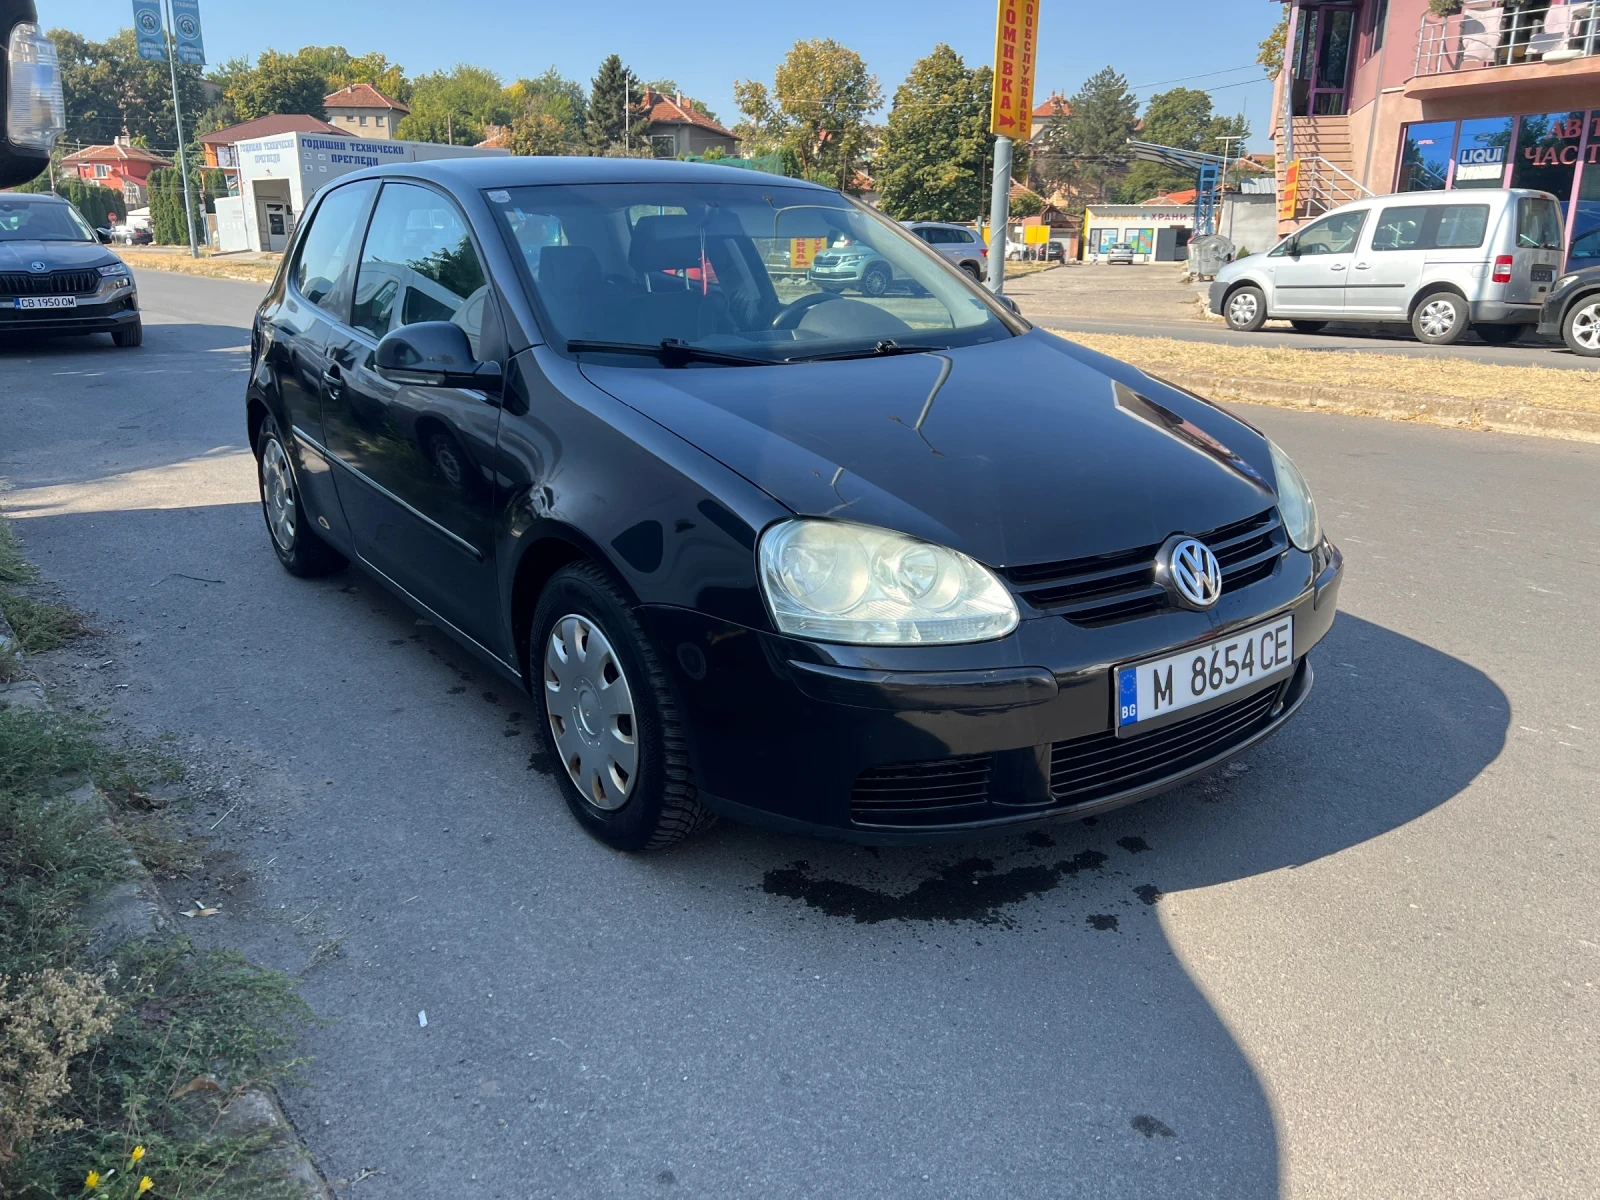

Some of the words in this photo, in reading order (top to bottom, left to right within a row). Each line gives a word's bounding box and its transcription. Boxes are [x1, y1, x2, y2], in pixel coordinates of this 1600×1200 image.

[1019, 0, 1034, 132] ООБСЛУЖВАНЕ
[301, 138, 346, 151] ГОДИШНИ
[350, 142, 404, 155] ТЕХНИЧЕСКИ
[331, 153, 379, 167] ПРЕГЛЕДИ
[1461, 148, 1502, 163] LIQUI
[1150, 213, 1187, 221] ХРАНИ
[37, 297, 60, 307] 1950
[1153, 664, 1173, 710] M
[1191, 638, 1255, 696] 8654
[1260, 624, 1288, 671] CE
[1121, 703, 1136, 719] BG
